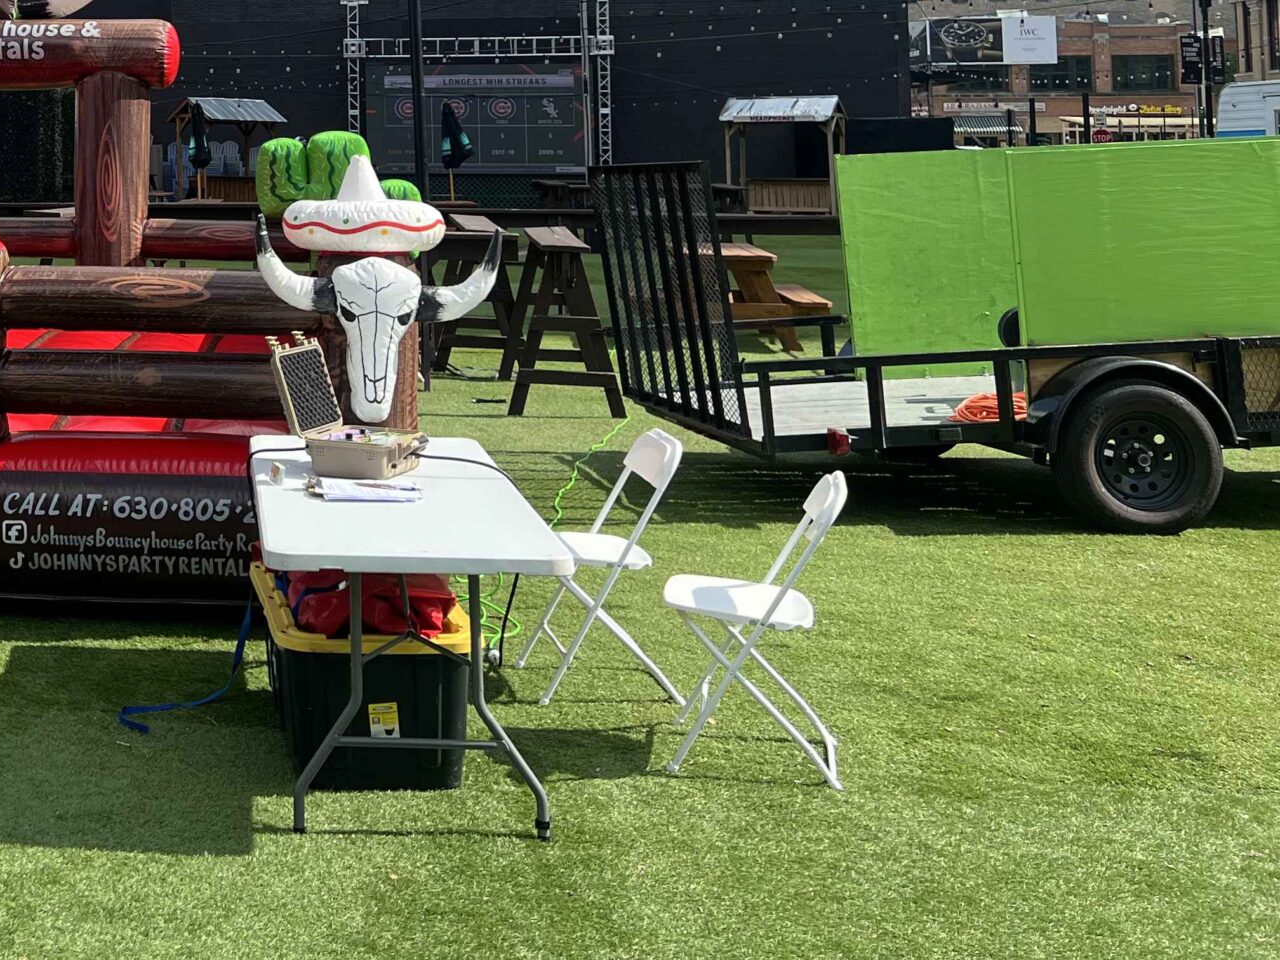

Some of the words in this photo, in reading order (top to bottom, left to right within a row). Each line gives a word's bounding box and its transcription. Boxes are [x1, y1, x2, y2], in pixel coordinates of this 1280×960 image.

[2, 20, 76, 38] house
[80, 20, 101, 38] &
[442, 77, 483, 86] LONGEST
[485, 77, 504, 86] WIN
[505, 77, 548, 86] STREAKS
[1092, 134, 1111, 143] STOP
[2, 492, 61, 516] CALL
